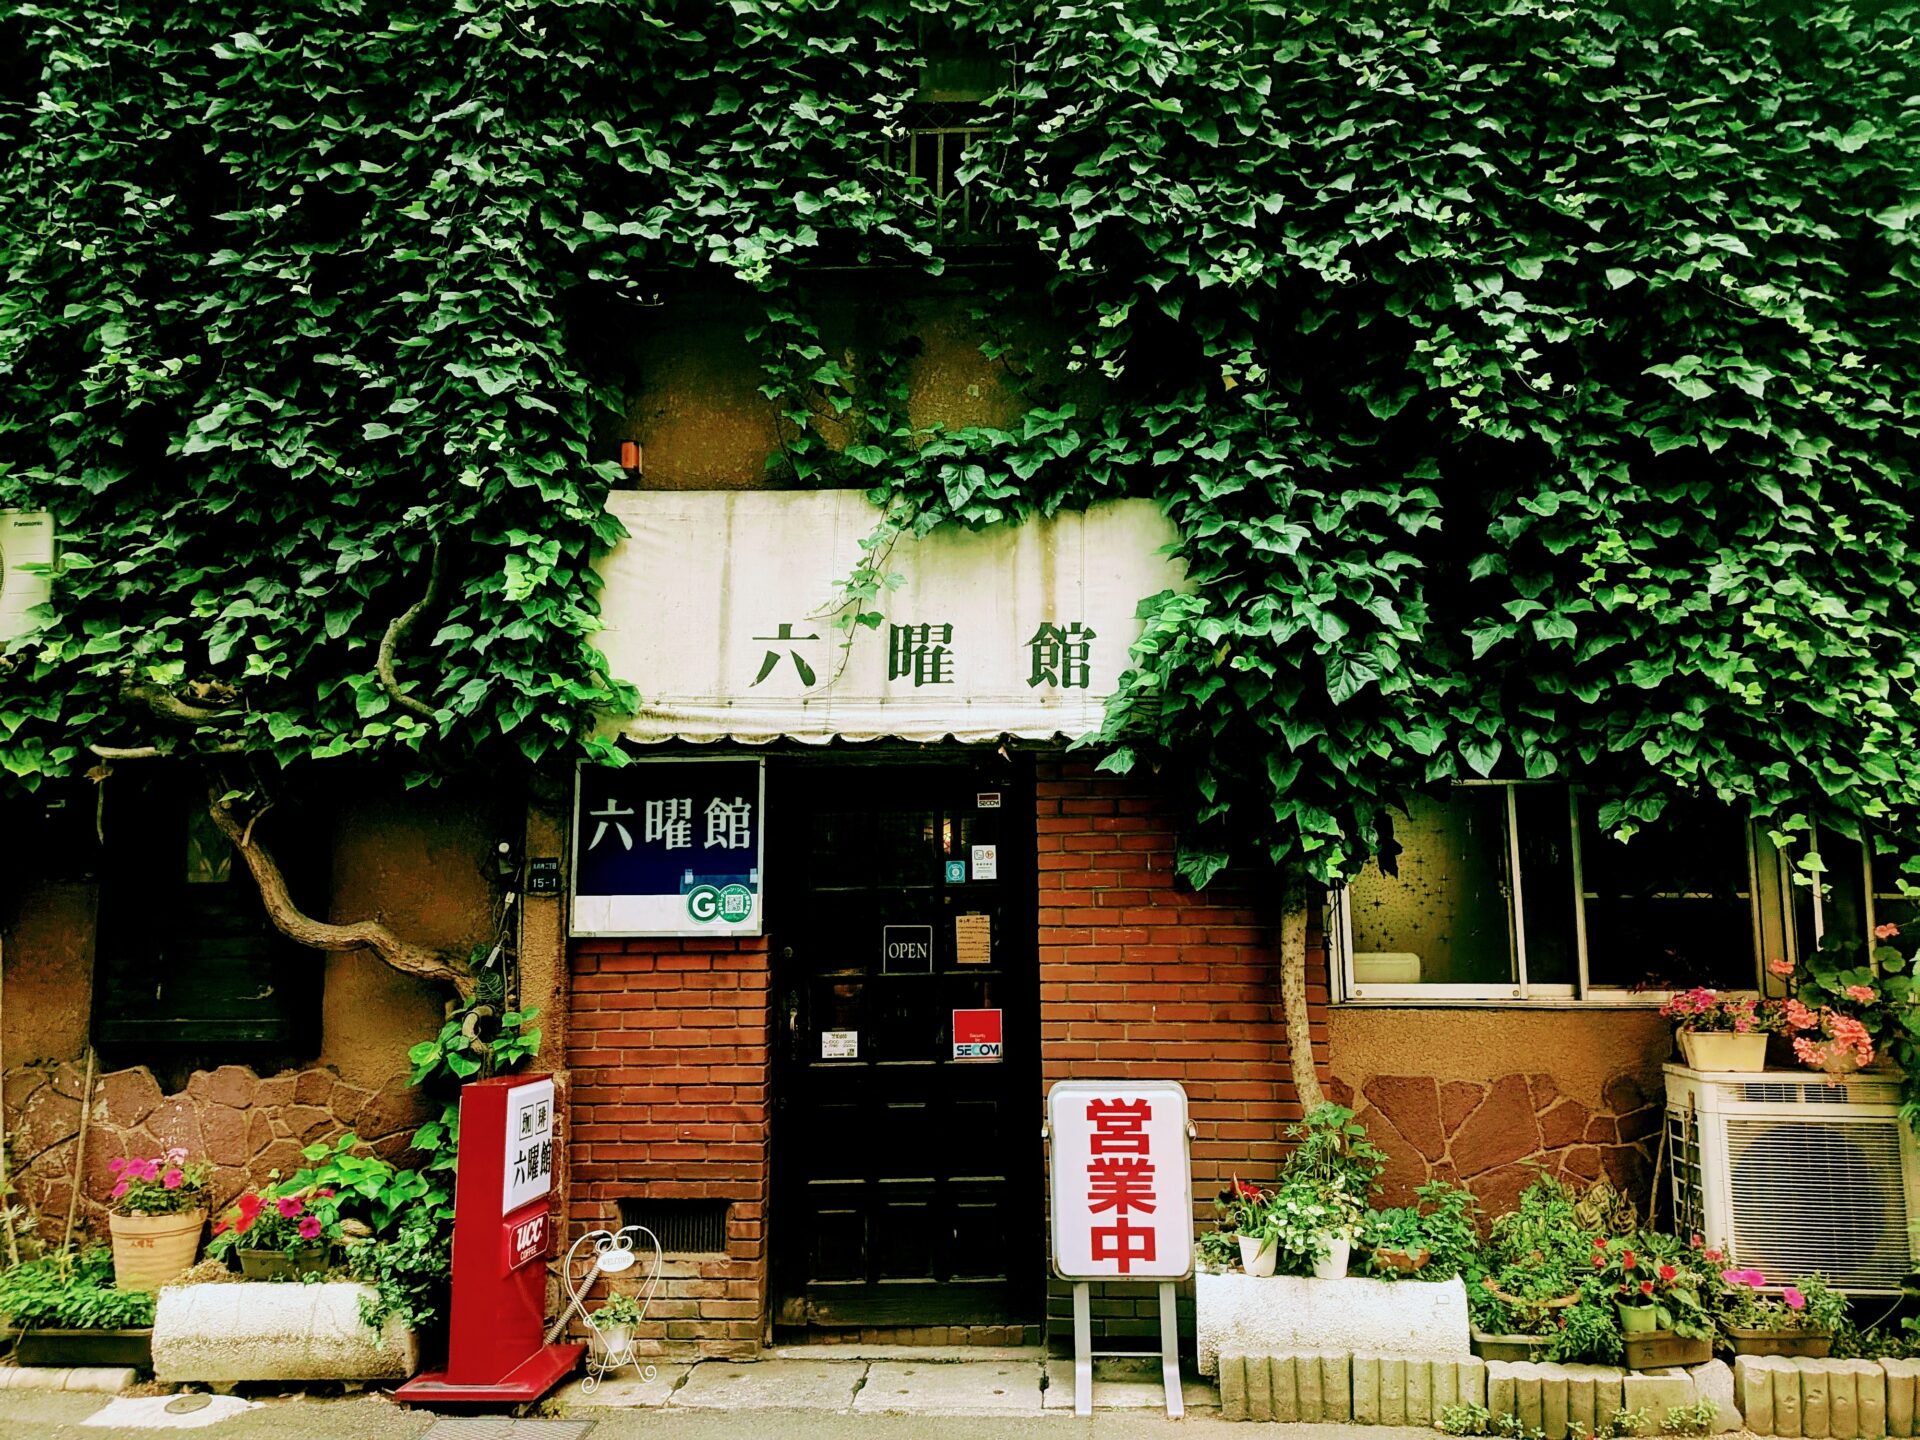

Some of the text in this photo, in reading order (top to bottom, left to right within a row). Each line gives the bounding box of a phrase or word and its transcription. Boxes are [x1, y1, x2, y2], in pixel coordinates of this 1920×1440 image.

[749, 622, 1097, 689] 六曜館
[587, 797, 752, 851] 六曜館
[533, 878, 556, 888] 15-1
[692, 892, 716, 918] G
[888, 942, 928, 959] OPEN
[957, 1044, 999, 1055] SECOM
[513, 1138, 552, 1189] 六曜館
[1086, 1098, 1157, 1273] 営業中
[517, 1217, 544, 1252] UCC
[520, 1244, 537, 1261] COFFEE
[602, 1255, 631, 1266] WELCOME
